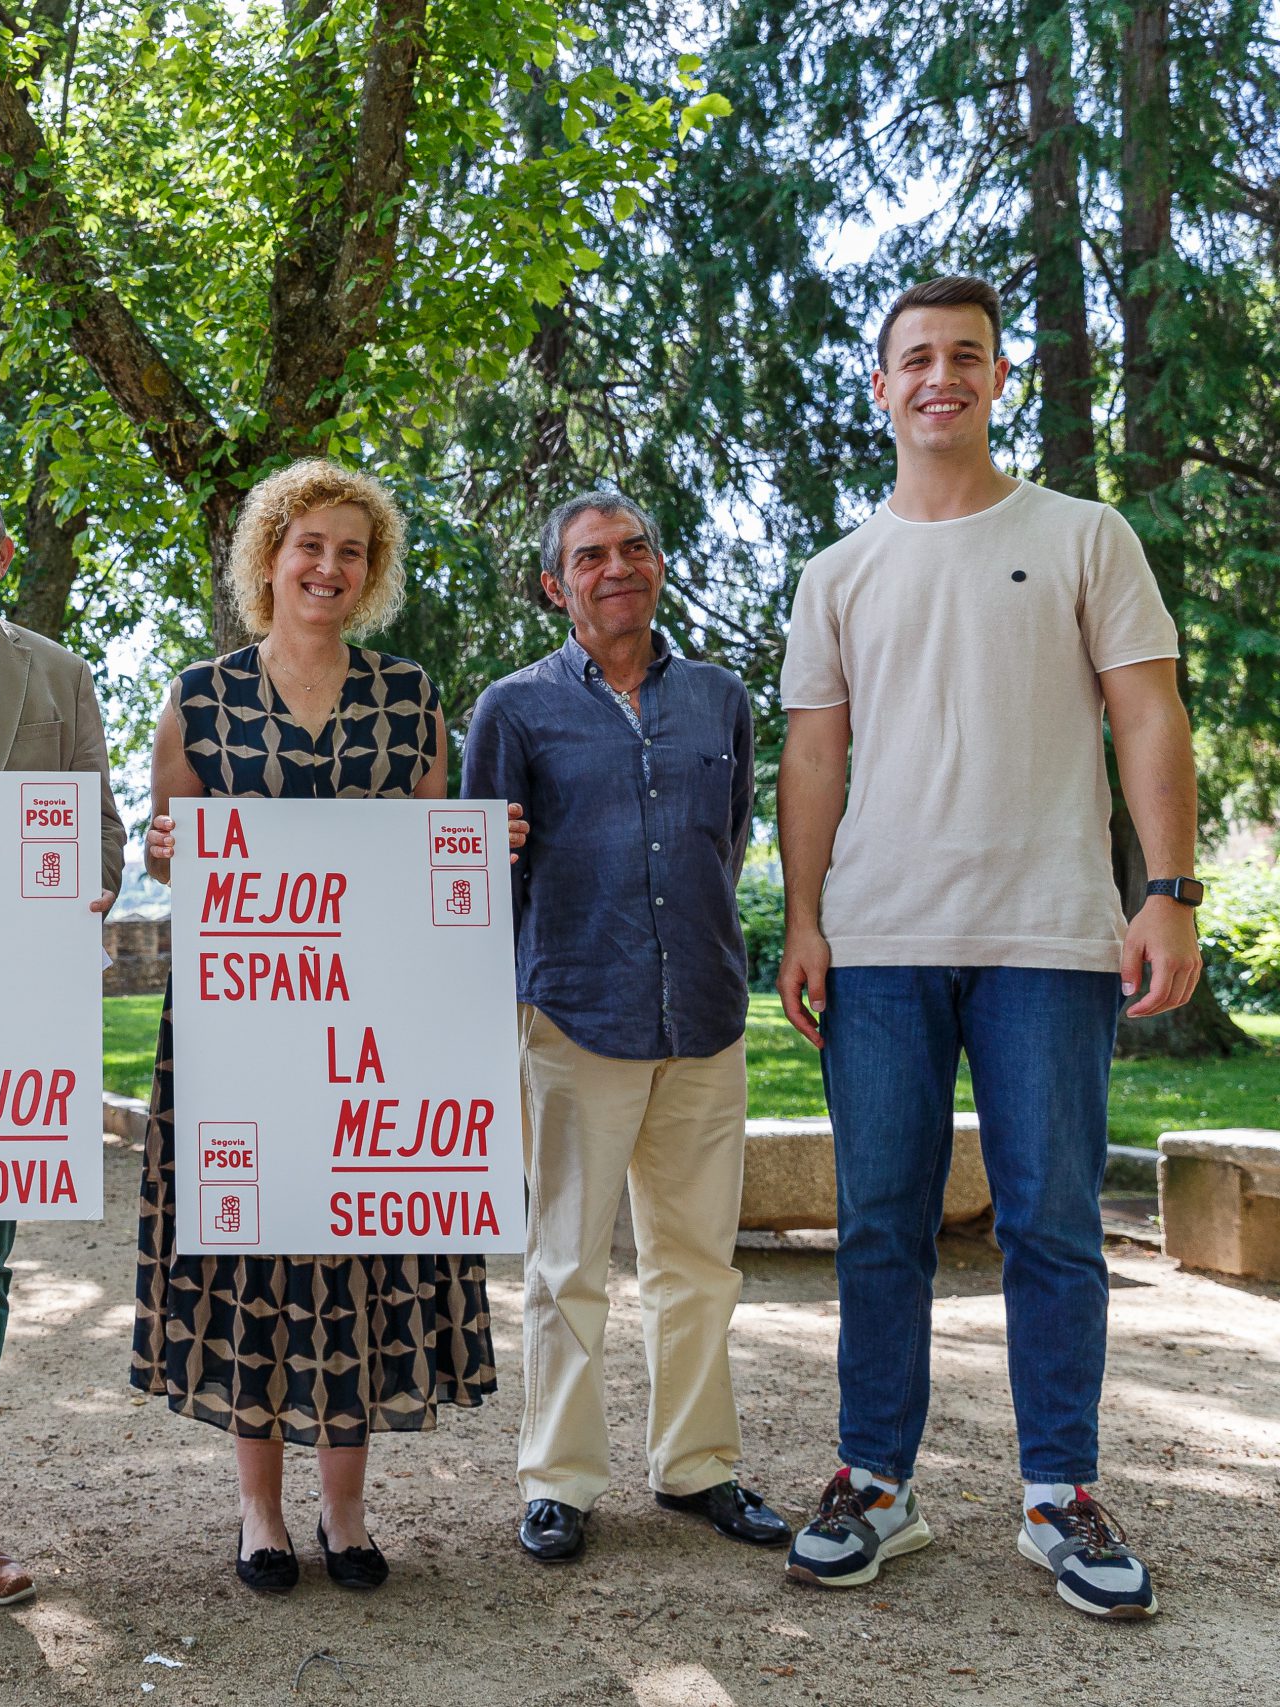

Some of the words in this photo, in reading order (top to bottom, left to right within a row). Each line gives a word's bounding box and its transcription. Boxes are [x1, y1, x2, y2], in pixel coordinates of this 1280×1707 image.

[26, 808, 74, 827] PSOE
[33, 798, 66, 807] Segovia
[197, 807, 249, 860] LA
[434, 836, 482, 855] PSOE
[441, 826, 474, 834] Segovia
[201, 871, 347, 925] MEJOR
[199, 945, 350, 1002] ESPAÑA
[327, 1026, 385, 1084] LA
[211, 1139, 245, 1147] Segovia
[332, 1098, 495, 1157] MEJOR
[204, 1149, 254, 1168] PSOE
[330, 1190, 501, 1237] SEGOVIA
